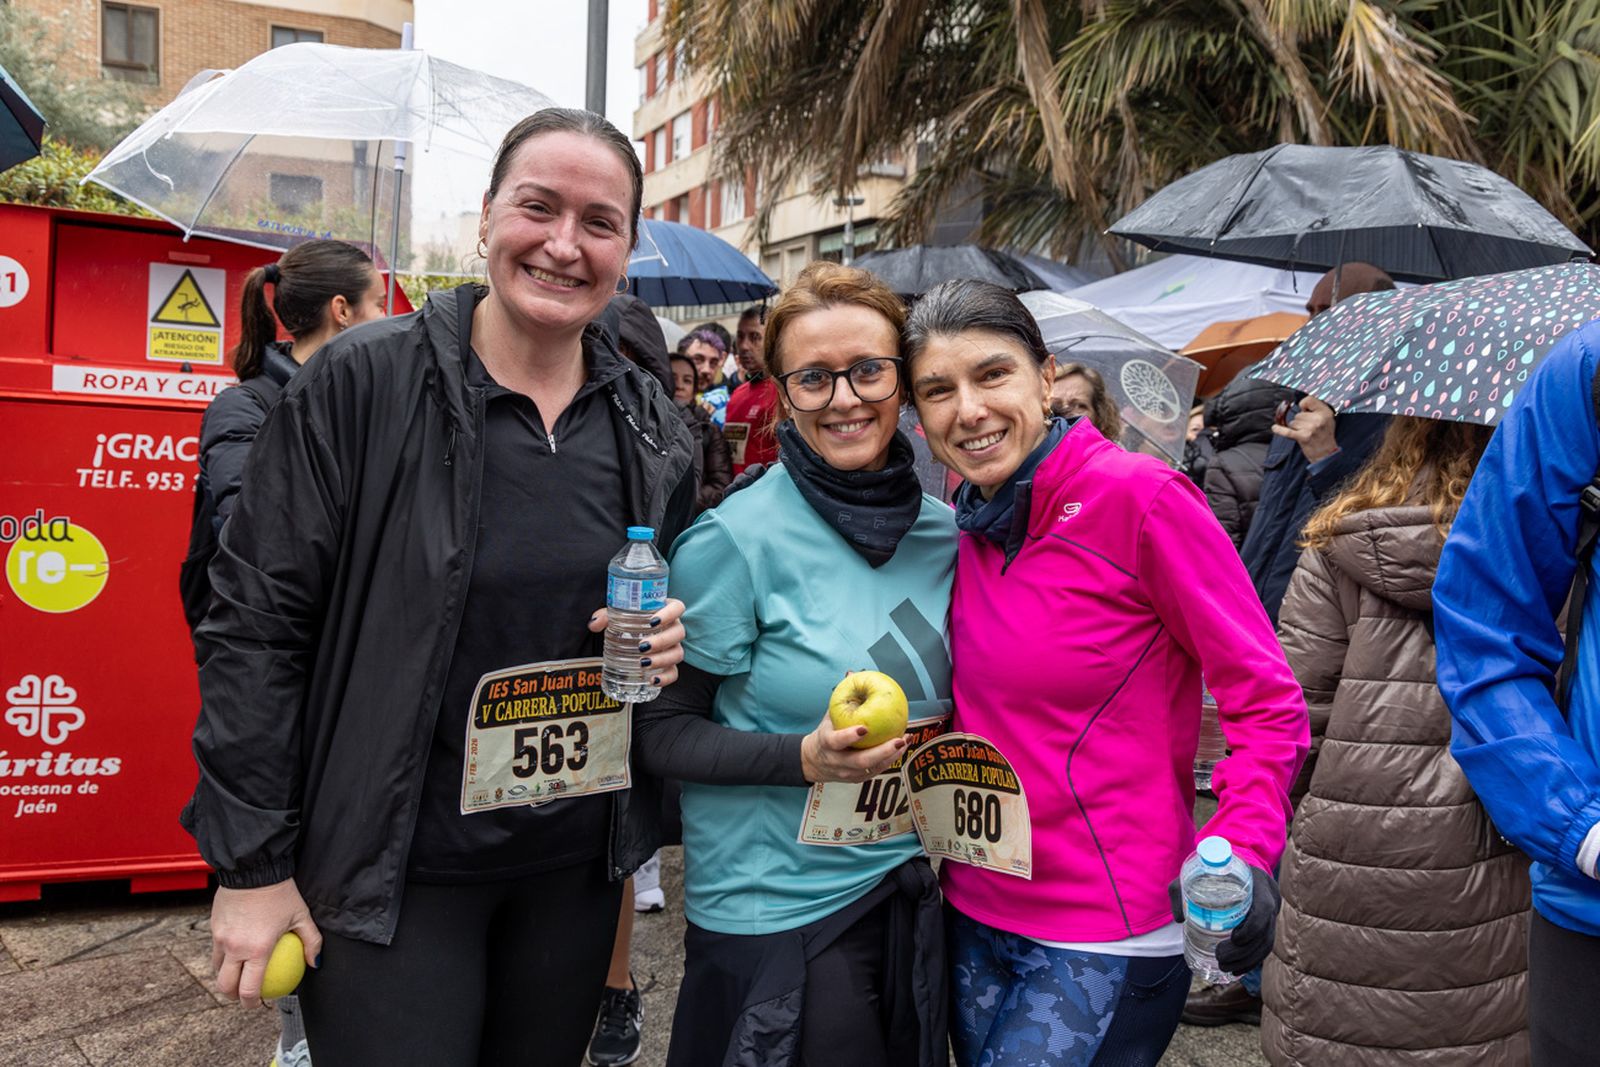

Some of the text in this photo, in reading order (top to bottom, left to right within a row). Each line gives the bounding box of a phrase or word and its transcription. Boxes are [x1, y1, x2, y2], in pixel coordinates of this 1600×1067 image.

[0, 272, 16, 292] 1
[83, 373, 148, 392] ROPA
[156, 378, 169, 392] Y
[146, 471, 185, 492] 953
[488, 681, 509, 700] IES
[512, 678, 537, 696] San
[541, 673, 573, 692] Juan
[482, 704, 491, 723] V
[495, 696, 558, 721] CARRERA
[512, 721, 589, 778] 563
[914, 749, 934, 770] IES
[938, 744, 964, 760] San
[77, 780, 99, 794] de
[914, 762, 1018, 789] V CARRERA POPULAR
[14, 799, 57, 818] Jaén
[953, 788, 1002, 843] 680
